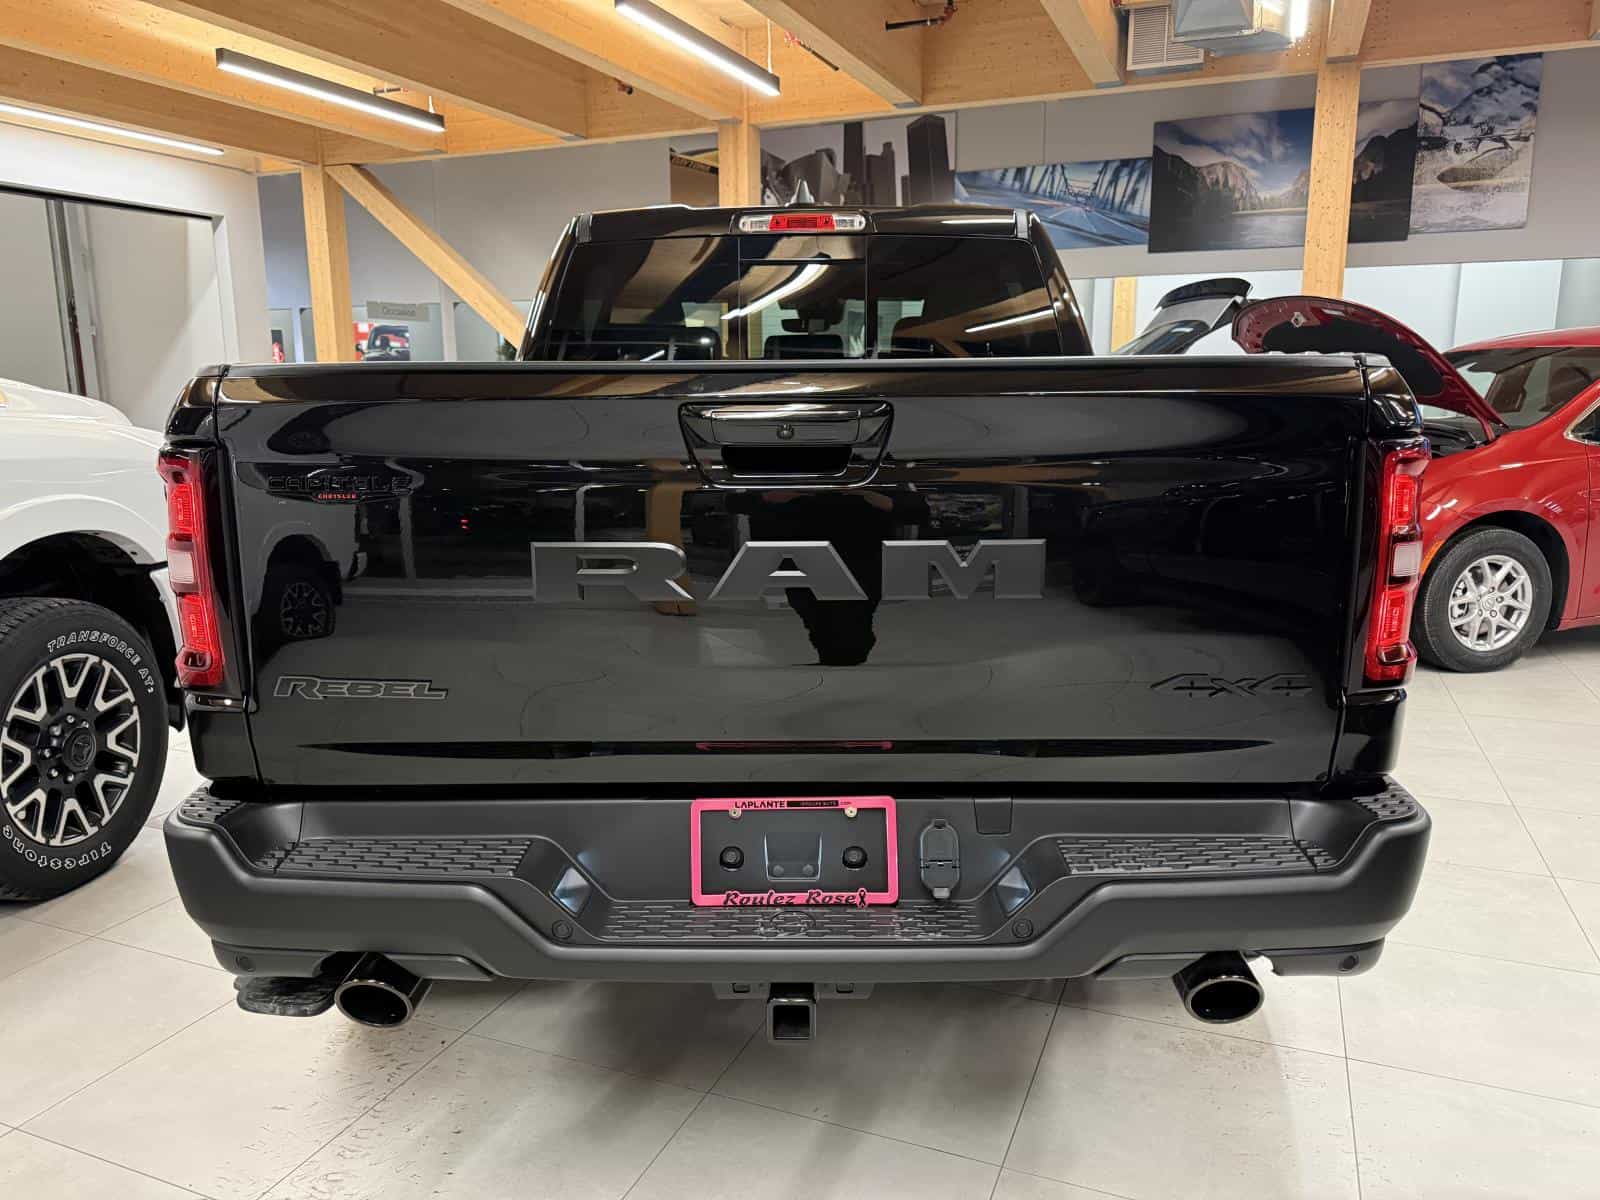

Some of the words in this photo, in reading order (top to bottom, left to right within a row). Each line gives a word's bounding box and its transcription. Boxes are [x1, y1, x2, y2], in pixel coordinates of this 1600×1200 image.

[530, 540, 1046, 600] RAM
[47, 630, 142, 666] TRANSFORCE
[734, 799, 786, 809] LAPLANTE
[723, 890, 796, 907] Roulez
[805, 890, 857, 906] Rose
